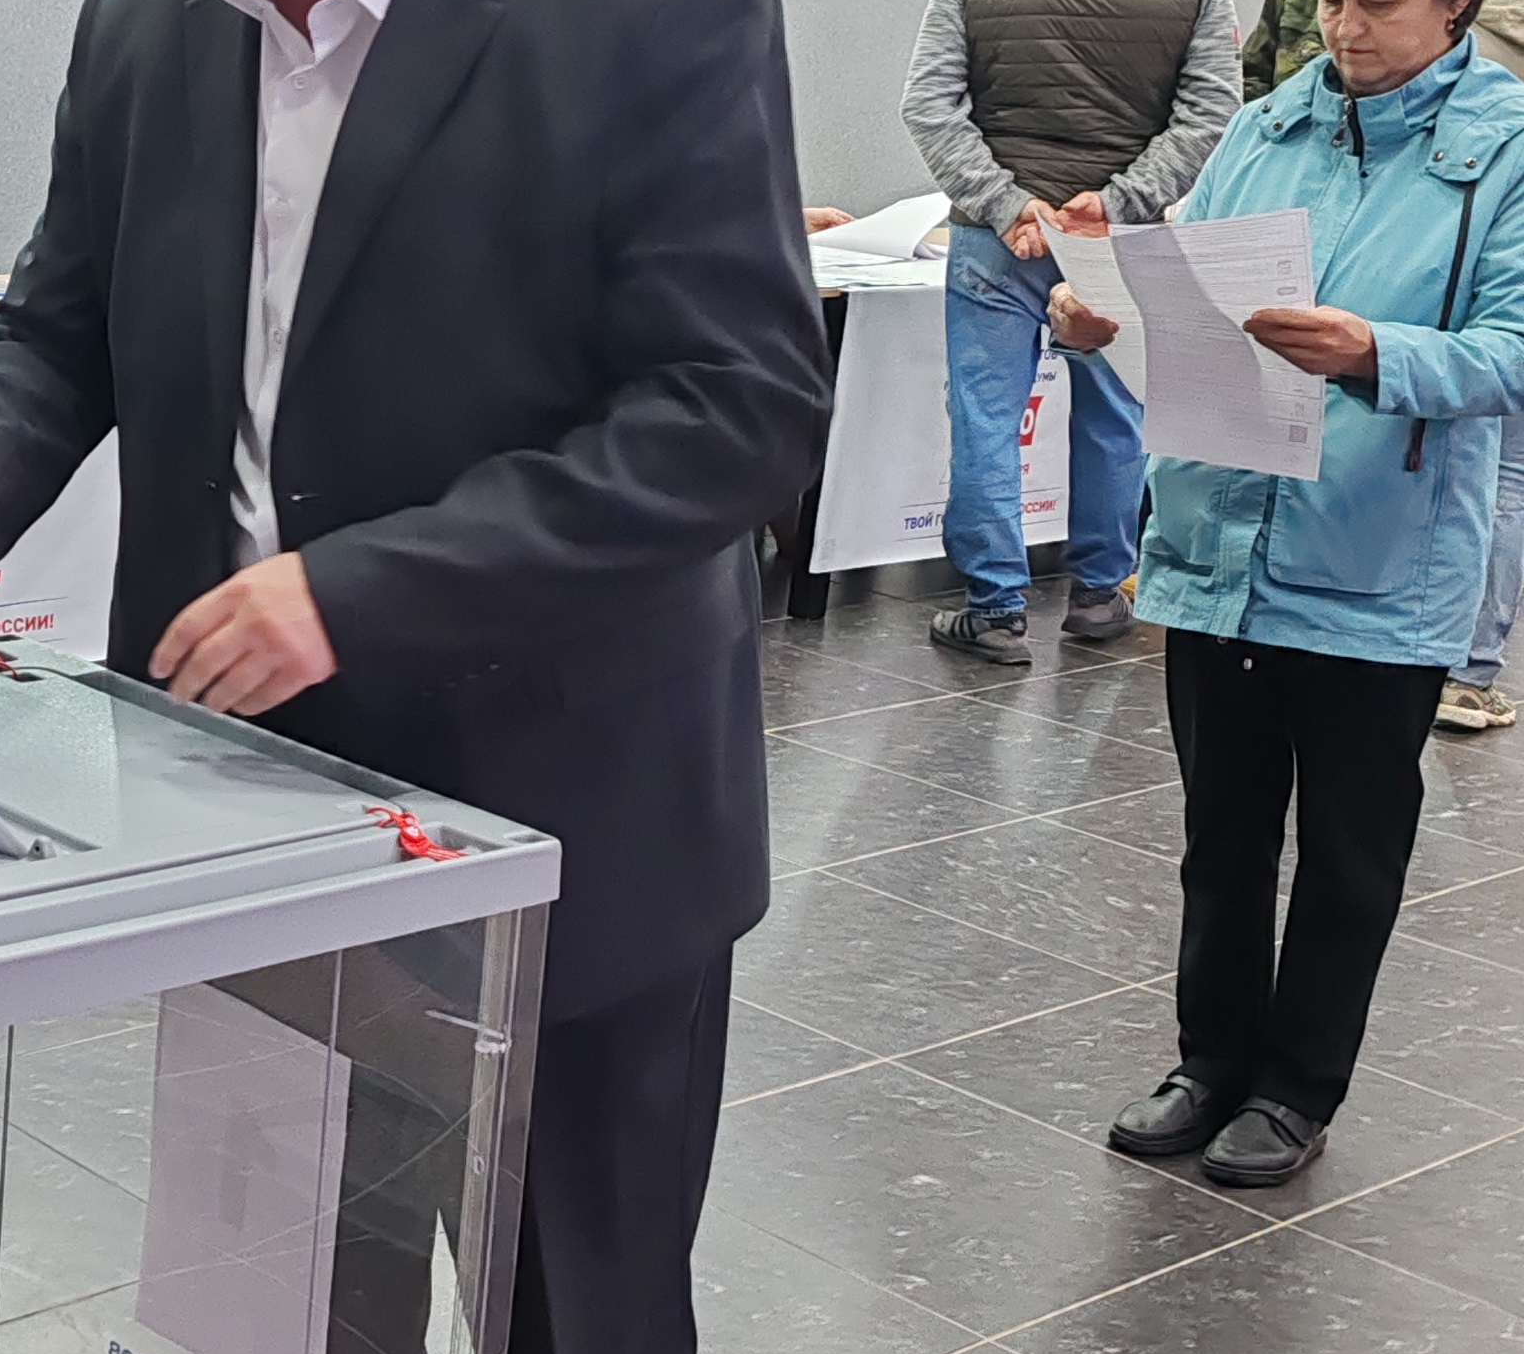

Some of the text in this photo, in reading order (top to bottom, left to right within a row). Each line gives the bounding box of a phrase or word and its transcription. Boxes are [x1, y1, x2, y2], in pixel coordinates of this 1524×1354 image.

[1037, 371, 1057, 383] УМЫ
[1021, 499, 1057, 514] ОССИИ!
[904, 511, 933, 530] ТВОЙ
